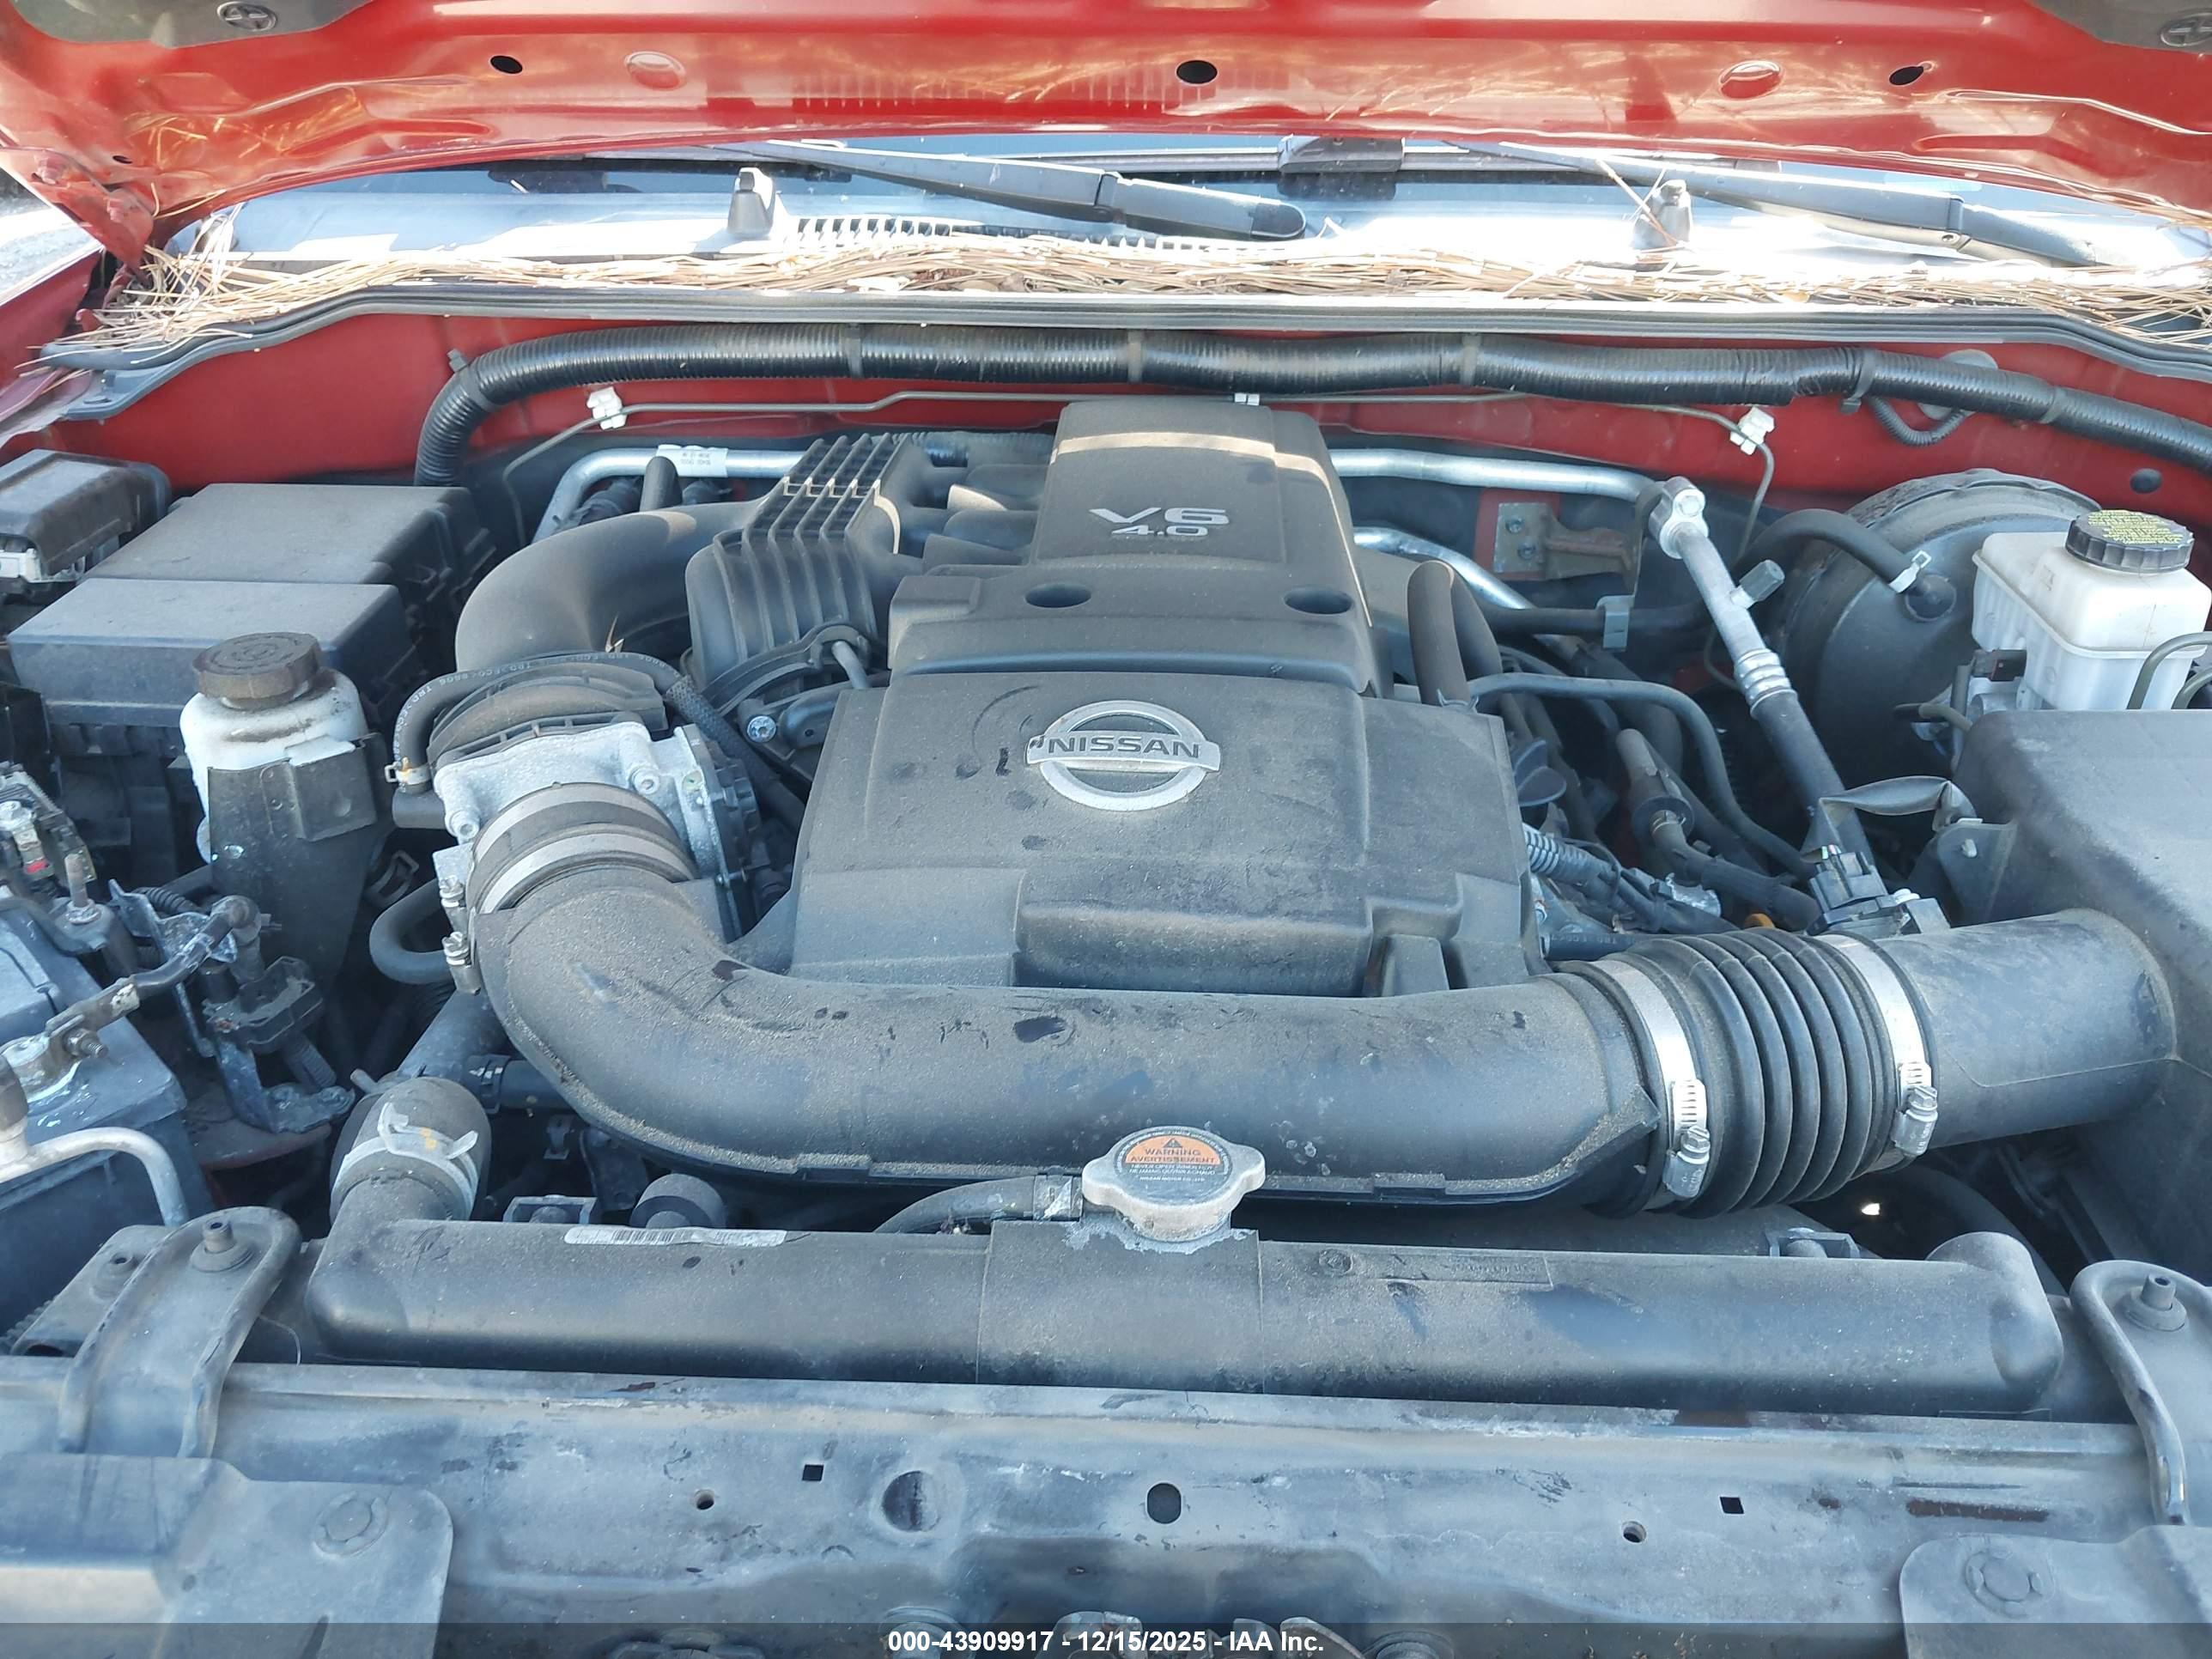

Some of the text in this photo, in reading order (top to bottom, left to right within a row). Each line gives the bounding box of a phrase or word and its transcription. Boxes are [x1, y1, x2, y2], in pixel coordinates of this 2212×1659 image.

[1088, 507, 1230, 525] V6
[1111, 525, 1209, 537] 4.0
[1048, 735, 1200, 759] NISSAN
